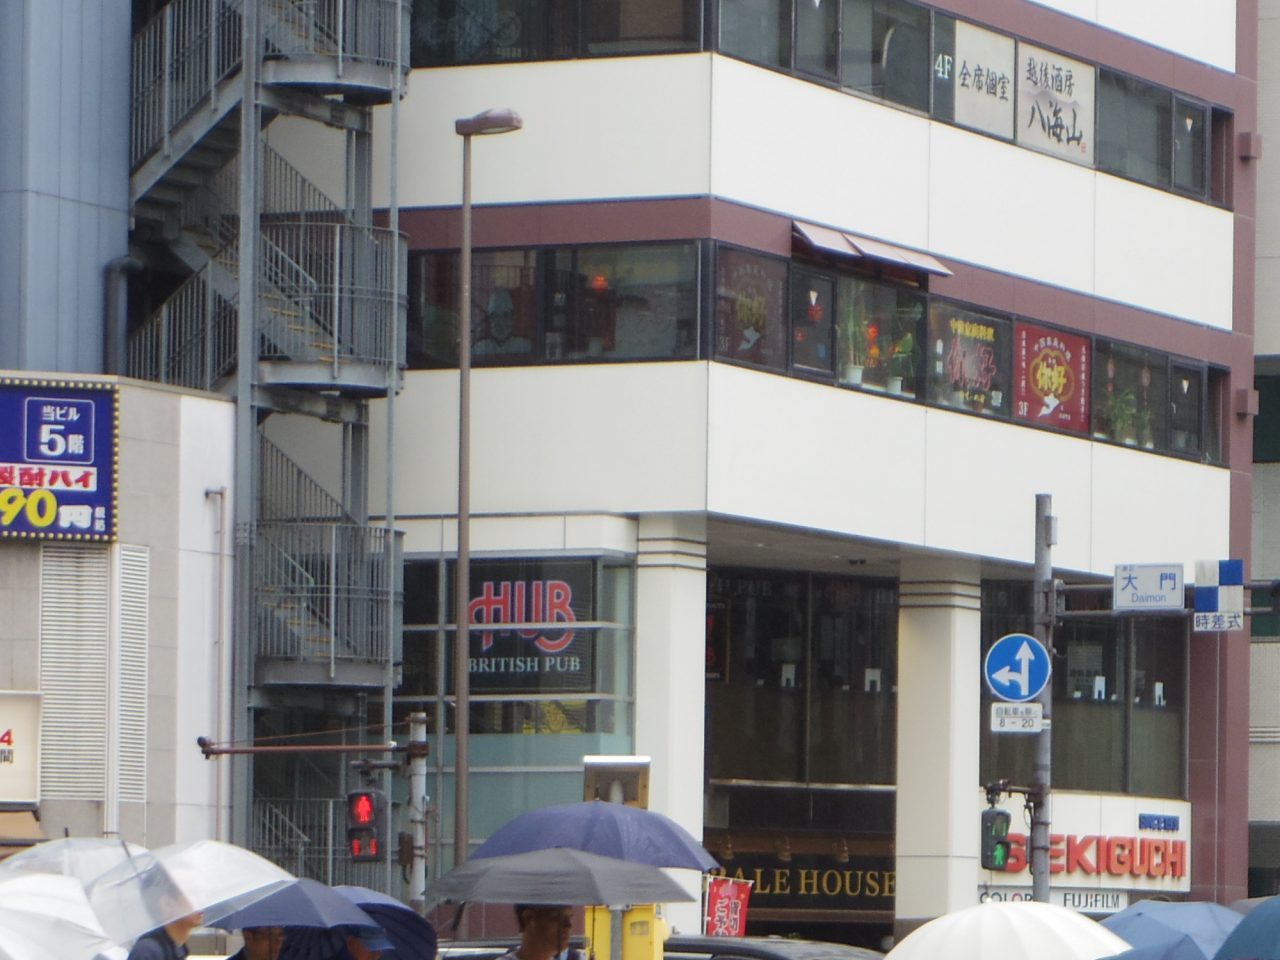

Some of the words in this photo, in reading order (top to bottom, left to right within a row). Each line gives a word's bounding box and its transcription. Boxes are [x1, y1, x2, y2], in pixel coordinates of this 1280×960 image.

[935, 53, 953, 79] 4F
[1026, 57, 1075, 97] 越後酒房
[958, 60, 1010, 101] 全席個室
[1028, 101, 1083, 146] 八海山
[42, 405, 80, 421] 当ビル
[40, 424, 85, 456] 5階
[1121, 573, 1177, 592] 大門
[1131, 592, 1167, 603] Daimon
[468, 580, 577, 652] HUB
[1195, 613, 1242, 629] 時差式
[469, 656, 539, 673] BRITISH
[544, 656, 581, 672] PUB
[1006, 833, 1187, 879] SEKIGUCHI
[798, 869, 896, 897] HOUSE
[1063, 892, 1120, 909] FUJIFILM
